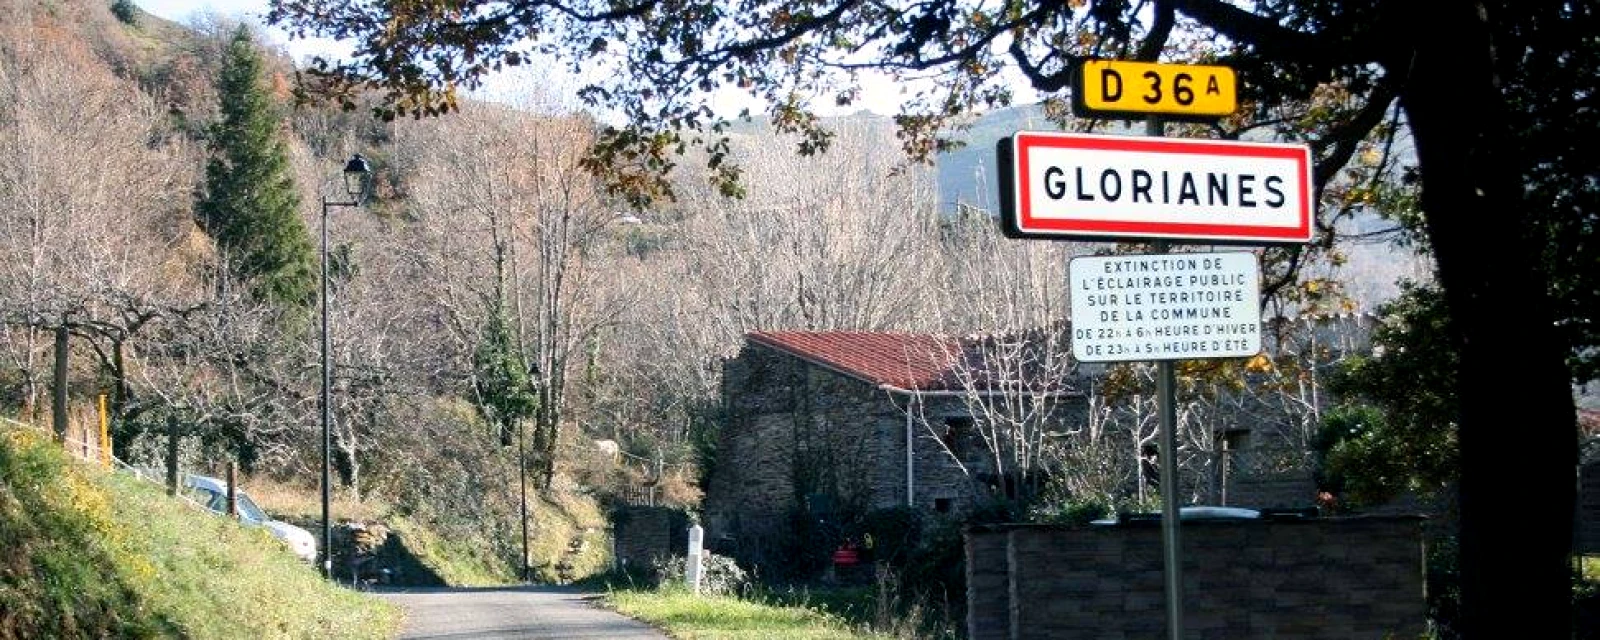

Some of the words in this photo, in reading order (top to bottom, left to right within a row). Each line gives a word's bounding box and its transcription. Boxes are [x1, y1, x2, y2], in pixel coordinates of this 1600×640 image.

[1101, 69, 1122, 102] D
[1044, 166, 1286, 208] GLORIANES
[1104, 259, 1196, 273] EXTINCTION
[1203, 257, 1222, 270] DE
[1189, 273, 1245, 286] PUBLIC
[1088, 294, 1118, 306] SUR
[1125, 293, 1142, 305] LE
[1150, 290, 1243, 304] TERRITOIRE
[1100, 310, 1118, 322] DE
[1126, 309, 1143, 321] LA
[1151, 307, 1231, 321] COMMUNE
[1076, 328, 1092, 340] DE
[1155, 325, 1199, 337] HEURE
[1204, 323, 1257, 335] D'HIVER
[1086, 344, 1102, 356] DE
[1163, 341, 1207, 353] HEURE
